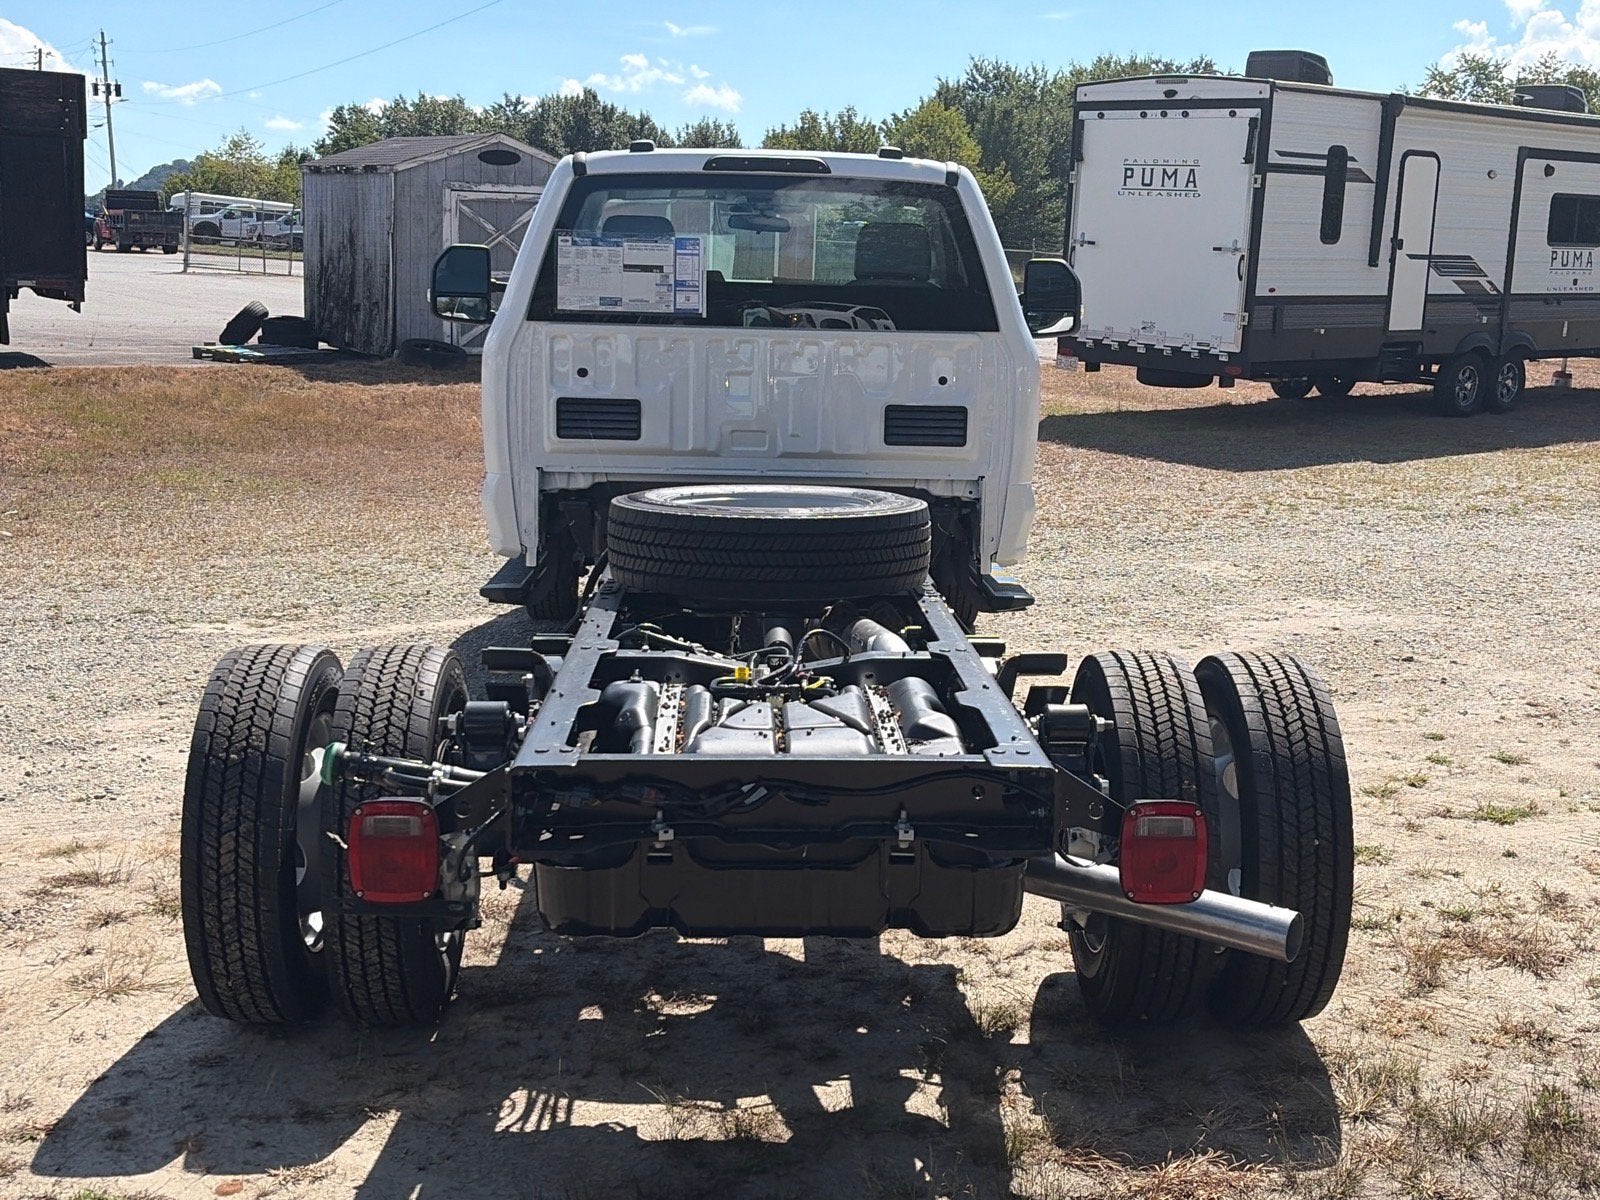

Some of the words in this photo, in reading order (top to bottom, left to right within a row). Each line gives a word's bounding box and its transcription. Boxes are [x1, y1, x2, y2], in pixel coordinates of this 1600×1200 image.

[1122, 167, 1197, 188] PUMA
[1117, 190, 1201, 198] UNLEASHED
[1550, 250, 1593, 268] PUMA
